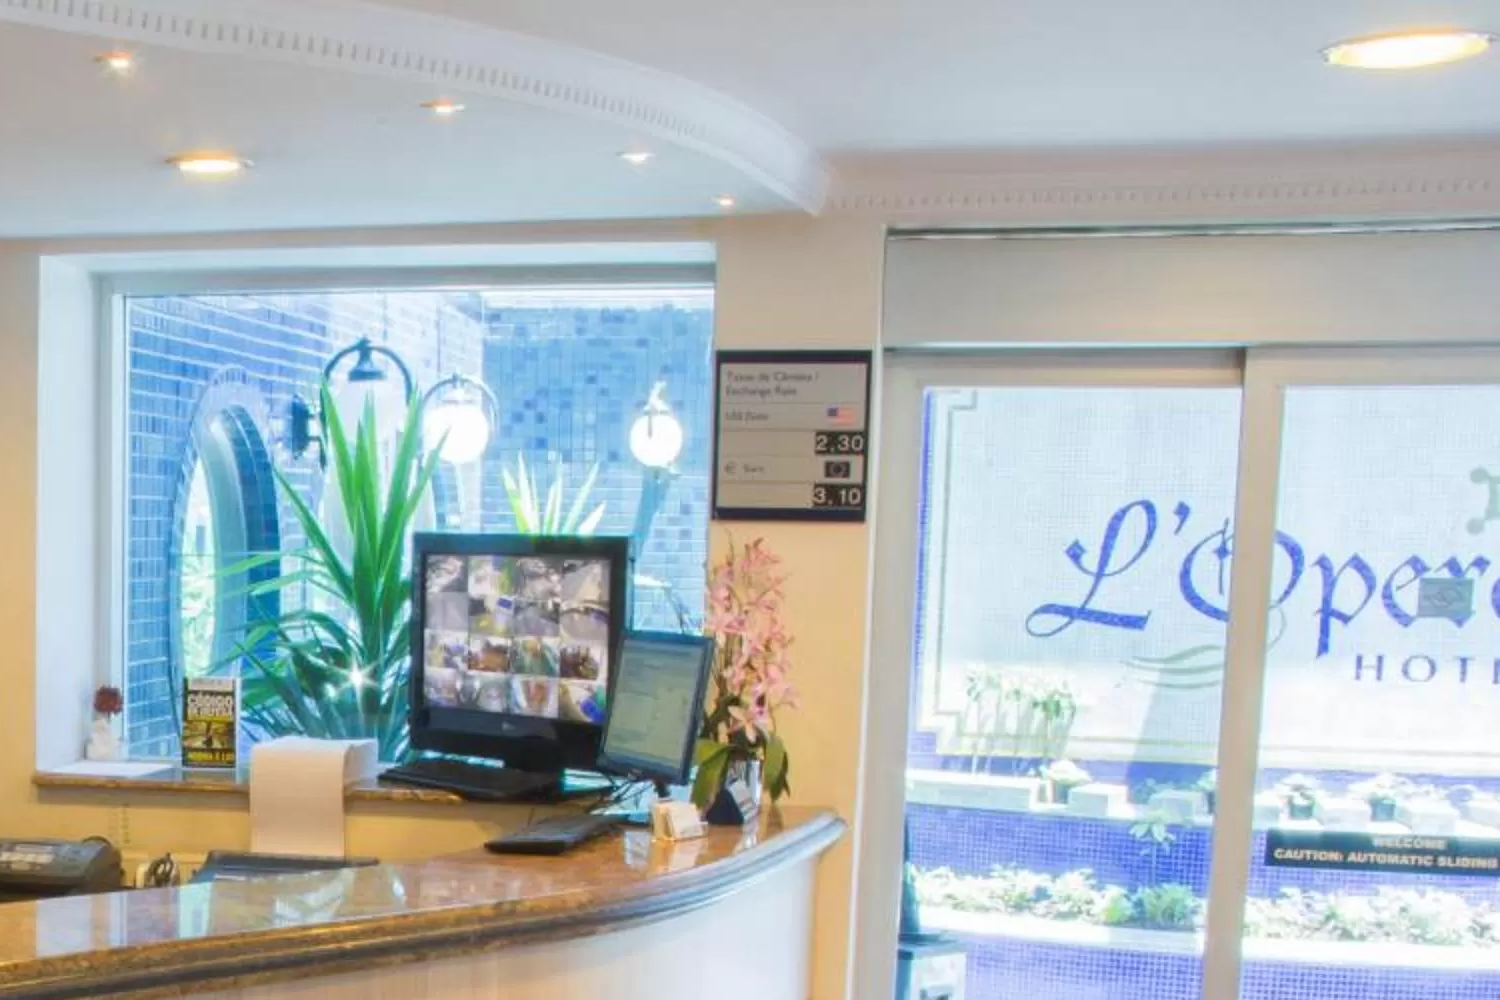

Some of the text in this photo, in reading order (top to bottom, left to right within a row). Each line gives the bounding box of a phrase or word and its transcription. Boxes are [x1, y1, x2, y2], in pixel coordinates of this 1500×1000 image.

[815, 434, 864, 453] 2.30
[813, 486, 862, 506] 3.10
[1025, 499, 1500, 658] L'Oper
[1372, 835, 1447, 850] WELCOME
[1273, 848, 1499, 869] CAUTION: AUTOMATIC SLIDING
